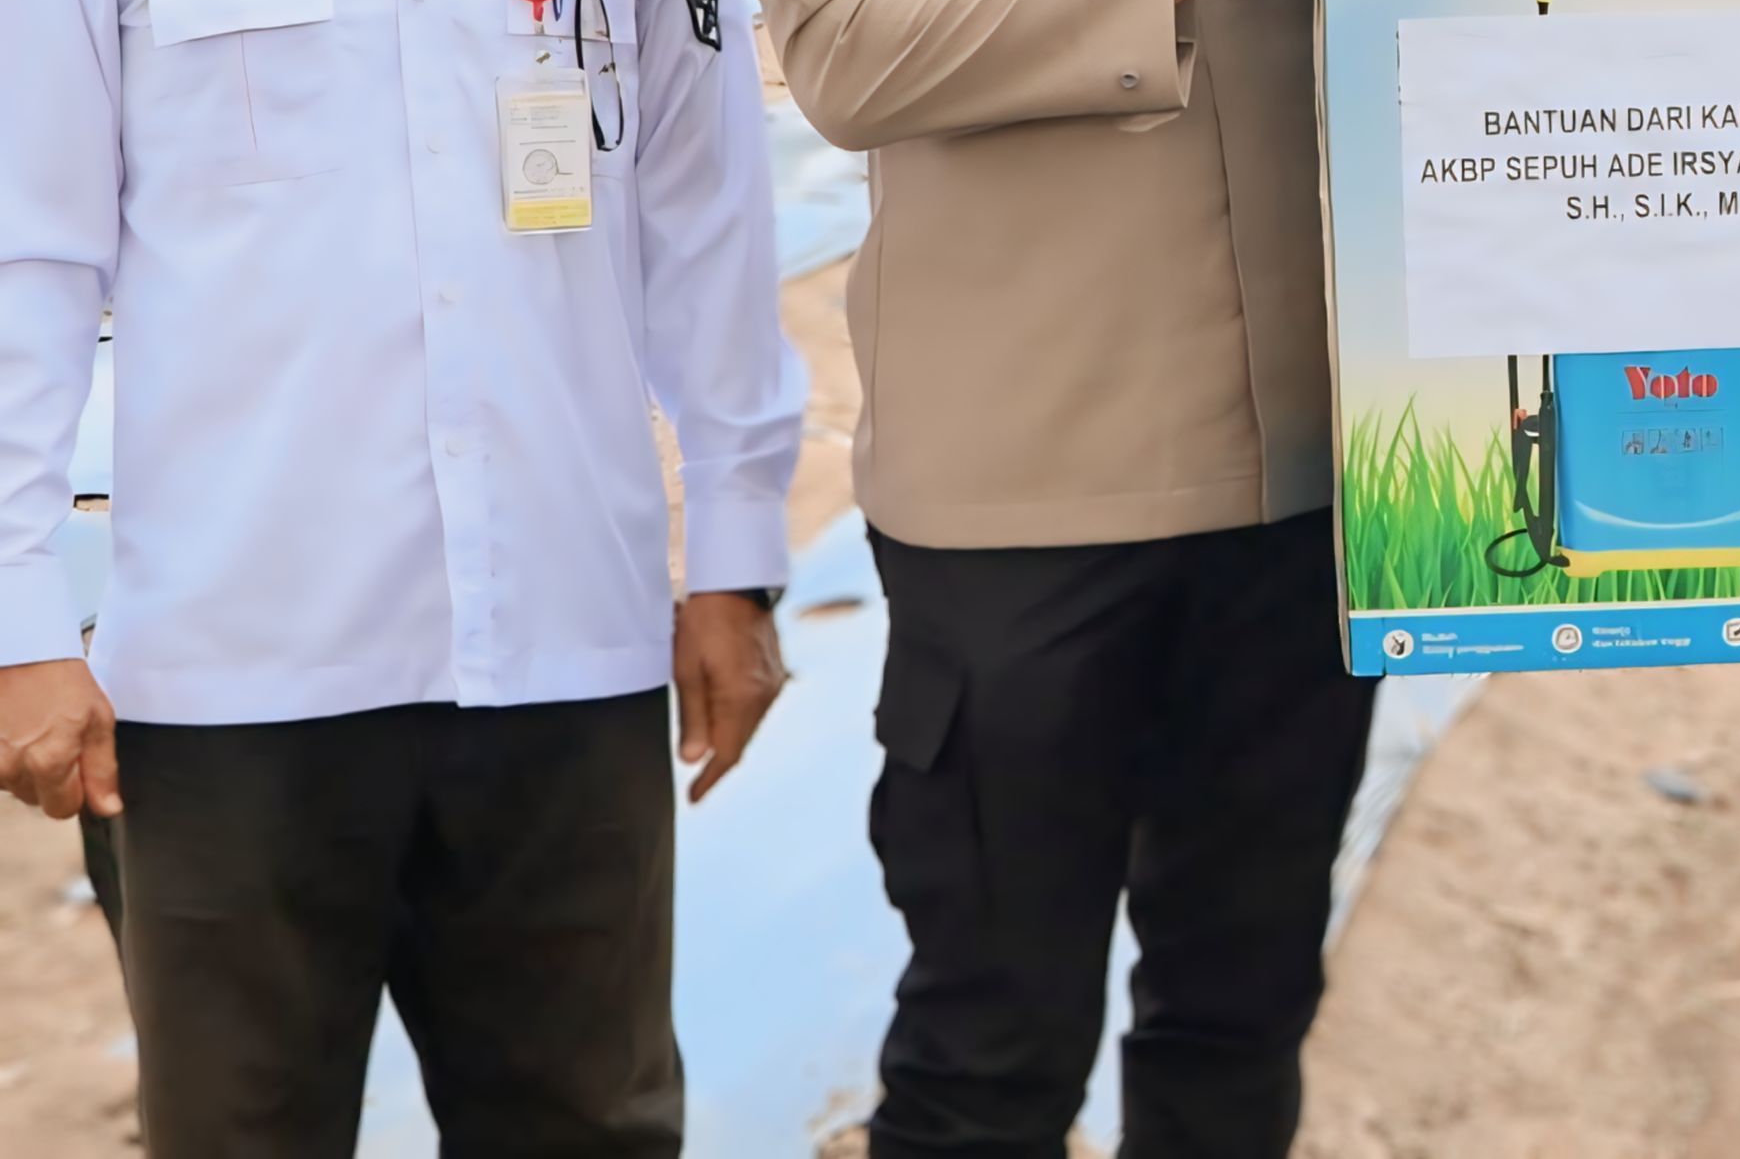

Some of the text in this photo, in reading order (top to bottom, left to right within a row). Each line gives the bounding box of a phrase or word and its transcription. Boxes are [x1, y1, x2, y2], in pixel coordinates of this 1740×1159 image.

[1484, 107, 1617, 136] BANTUAN
[1626, 105, 1692, 132] DARI
[1420, 157, 1496, 184] AKBP
[1505, 154, 1598, 181] SEPUH
[1607, 152, 1663, 179] ADE
[1566, 195, 1625, 223] S.H.,
[1634, 192, 1708, 220] S.I.K.,
[1623, 365, 1719, 401] Yoto
